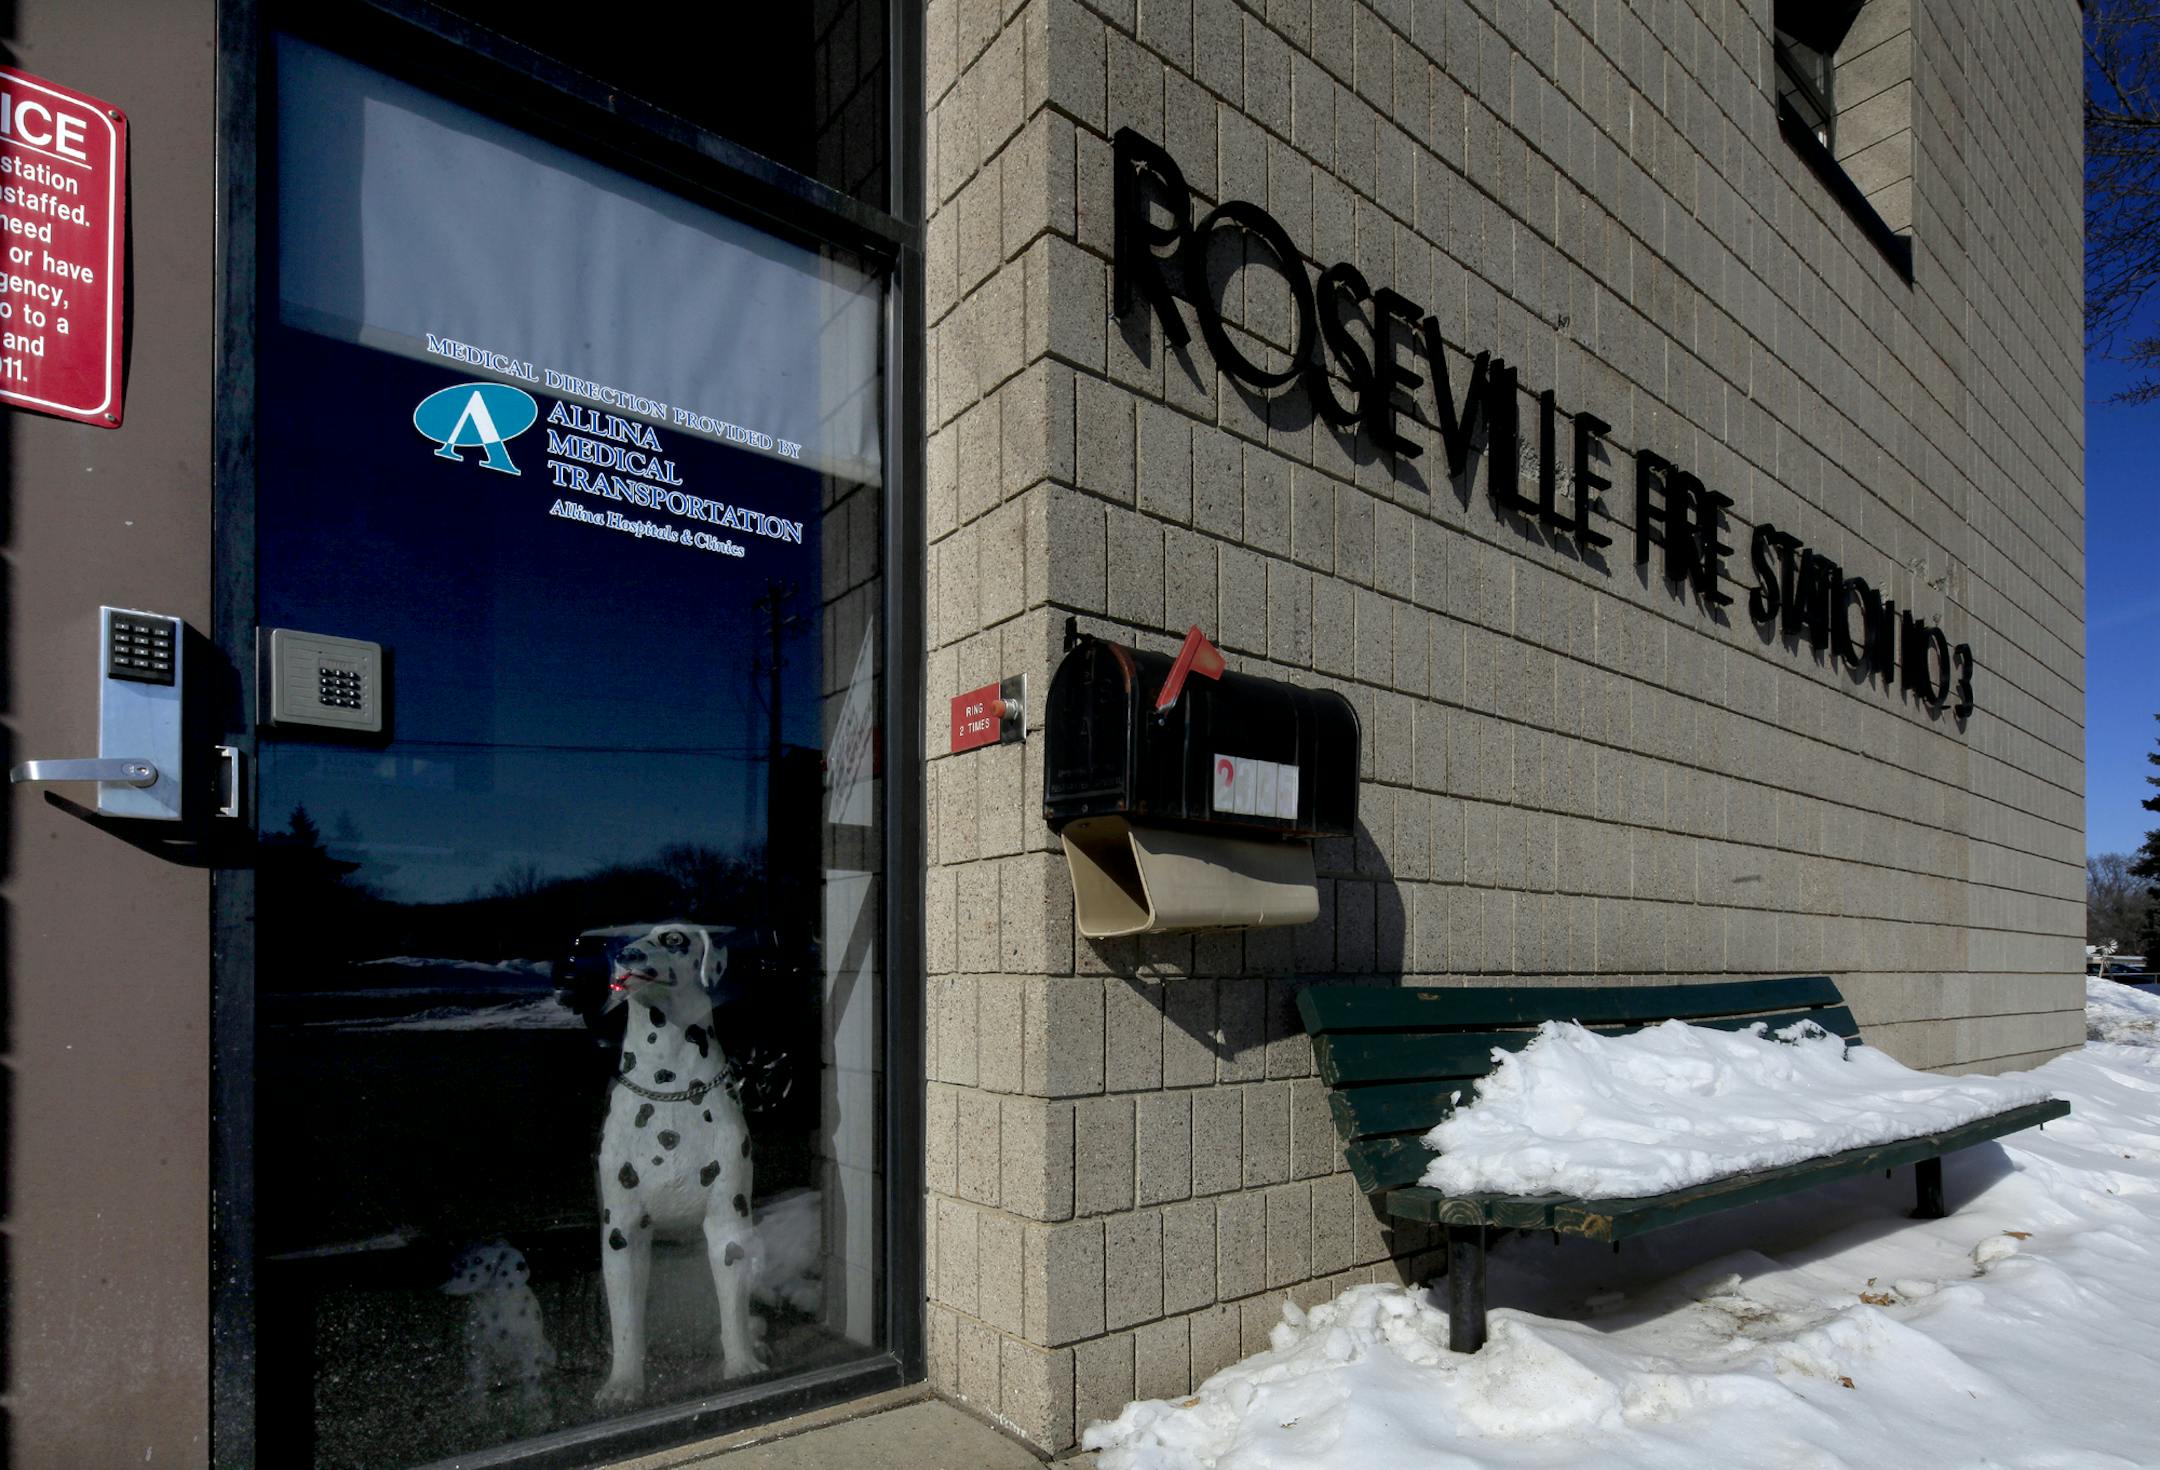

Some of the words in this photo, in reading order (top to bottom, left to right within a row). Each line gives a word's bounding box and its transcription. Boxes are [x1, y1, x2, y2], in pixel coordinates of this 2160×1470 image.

[0, 155, 78, 195] station
[0, 185, 90, 227] staffed.
[9, 246, 33, 266] or
[42, 250, 94, 284] have
[24, 303, 46, 328] to
[57, 317, 69, 334] a
[3, 331, 45, 357] and
[0, 357, 28, 382] 11.
[426, 333, 539, 383] MEDICAL
[544, 368, 668, 421] DIRECTION
[672, 407, 773, 450] PROVIDED
[778, 438, 802, 459] BY
[547, 400, 663, 453] ALLINA
[1113, 126, 1612, 547] ROSEVILLE
[1636, 448, 1735, 607] FIRE
[1749, 522, 1895, 685] STATION
[1953, 643, 1974, 719] 3
[547, 428, 683, 486] MEDICAL
[547, 459, 803, 544] TRANSPORTATION
[549, 498, 605, 526] Allina
[606, 510, 679, 538] Hospitals
[680, 528, 694, 546] &
[694, 531, 746, 558] Clinics
[959, 725, 964, 737] 2
[968, 717, 990, 734] TIMES
[965, 702, 984, 718] RING
